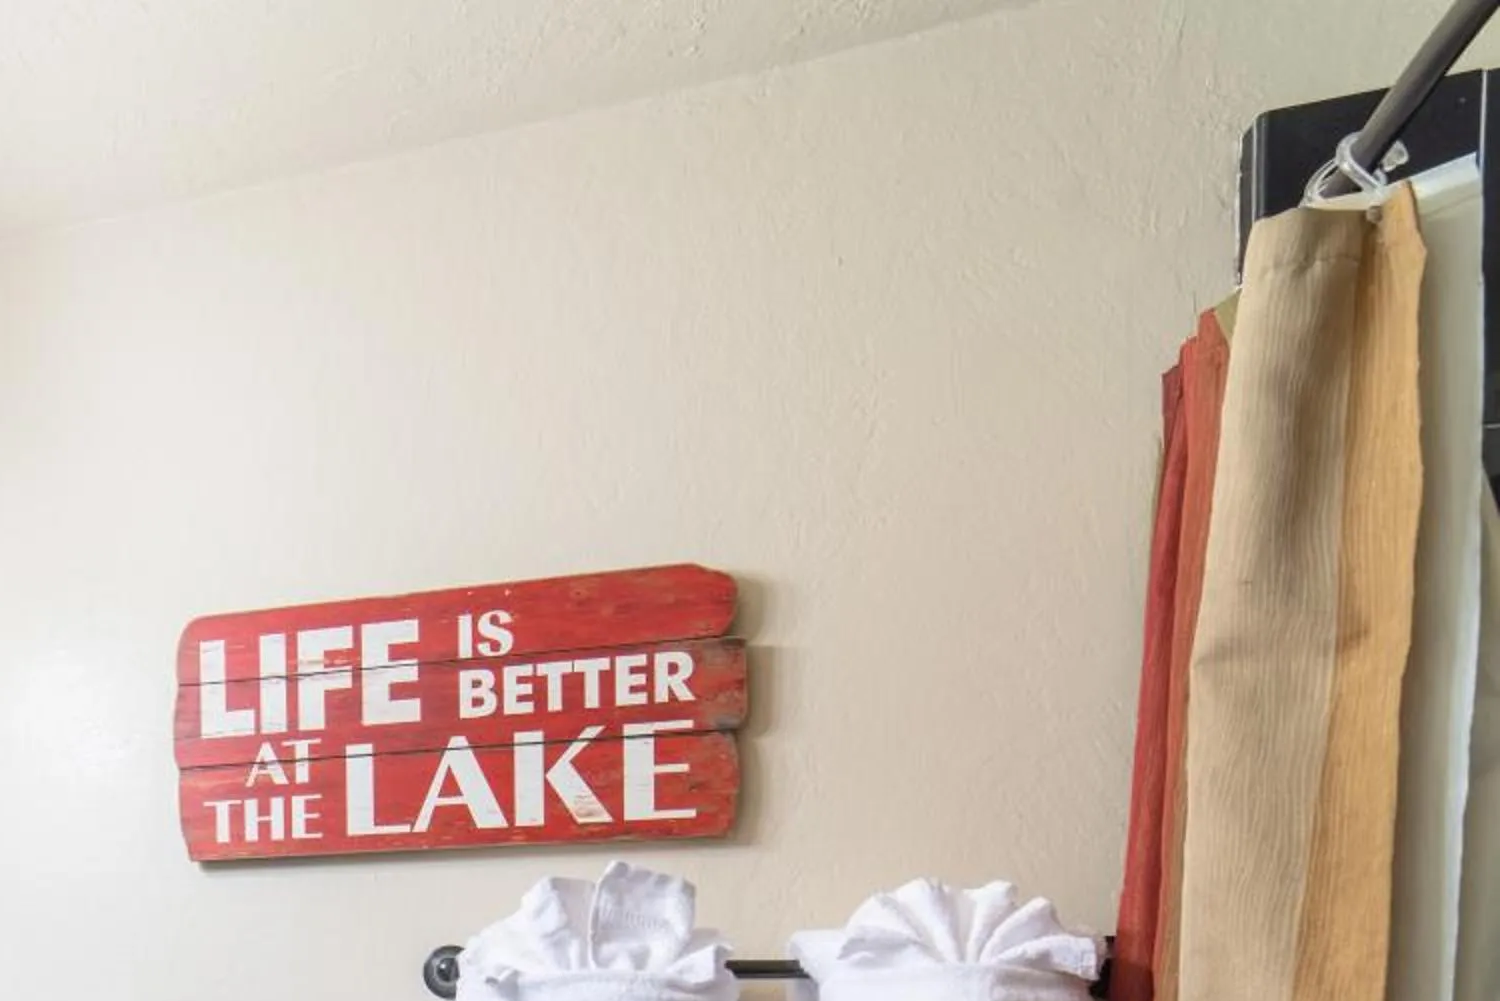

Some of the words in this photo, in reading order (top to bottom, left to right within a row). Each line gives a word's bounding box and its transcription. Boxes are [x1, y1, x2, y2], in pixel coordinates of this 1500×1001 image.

[200, 619, 421, 739] LIFE
[458, 610, 514, 659] IS
[458, 651, 696, 719] BETTER
[203, 794, 323, 844] THE
[345, 719, 697, 837] LAKE
[245, 738, 321, 788] AT
